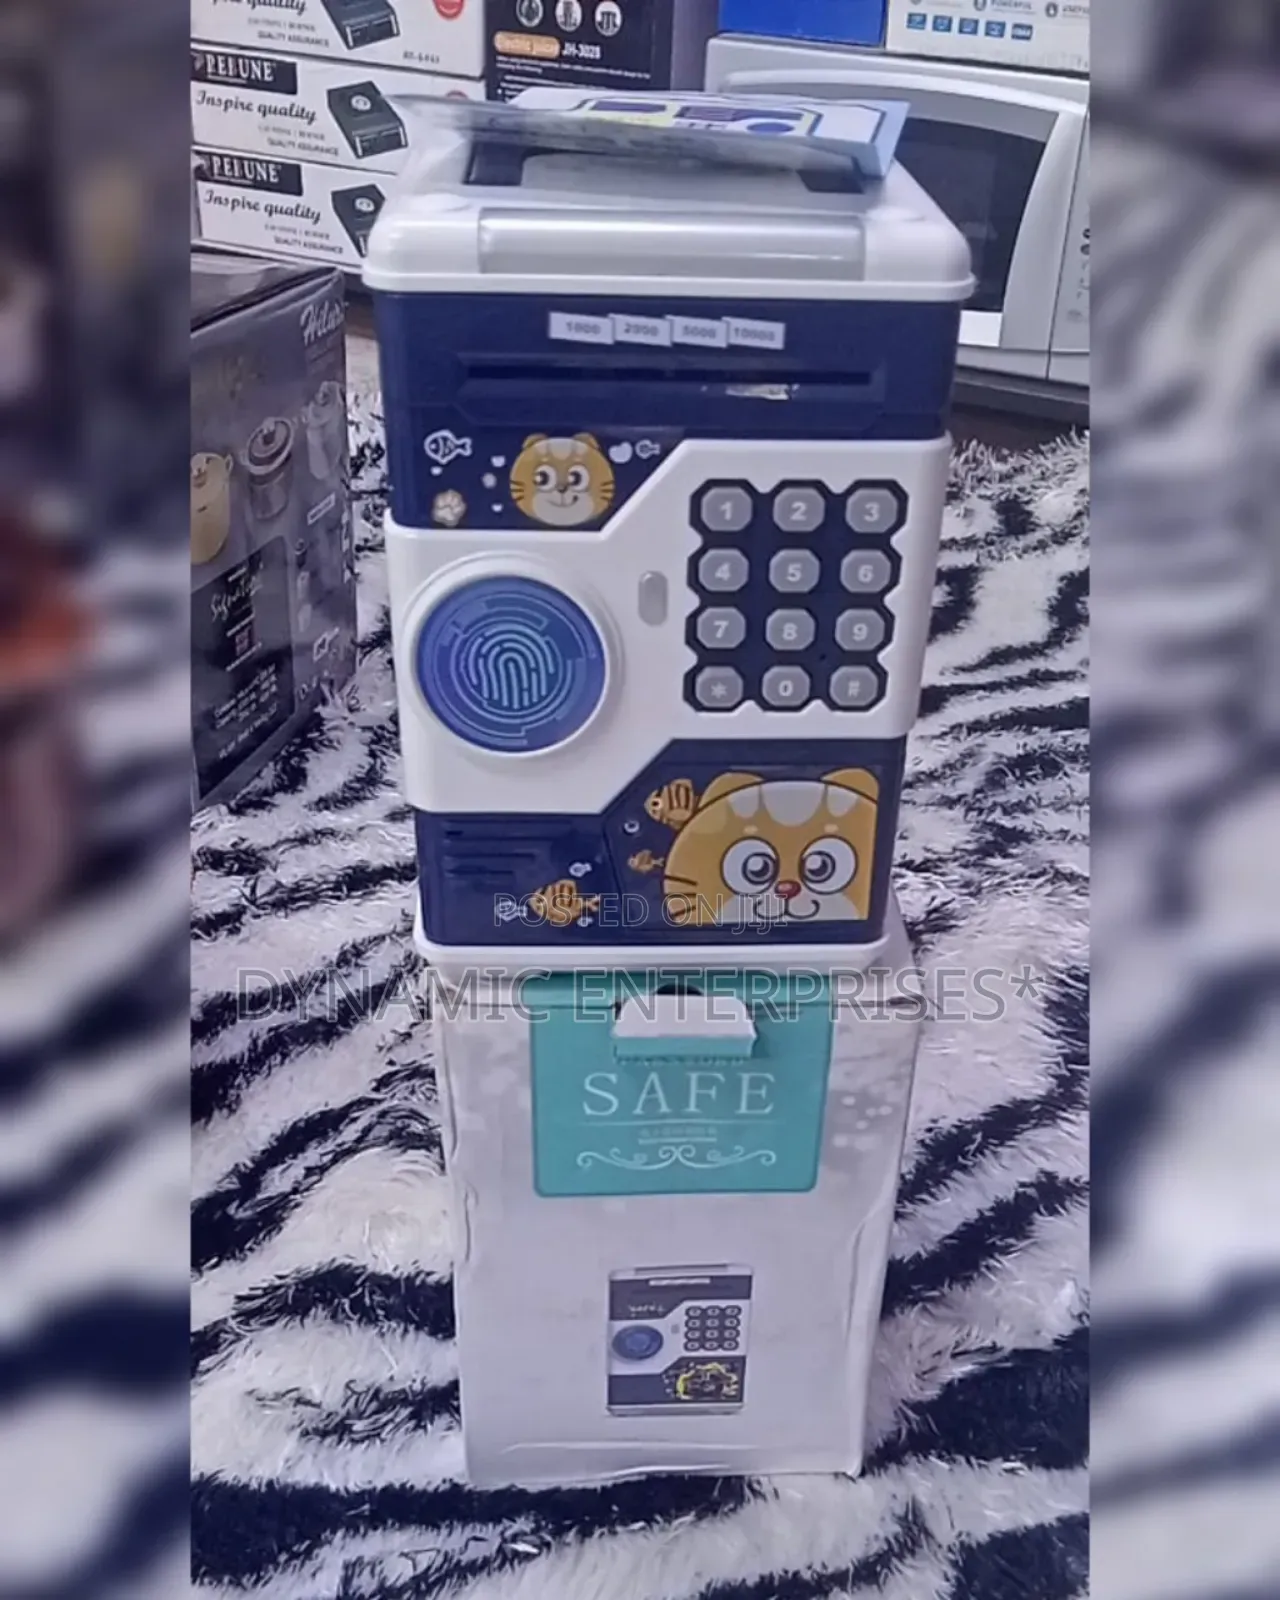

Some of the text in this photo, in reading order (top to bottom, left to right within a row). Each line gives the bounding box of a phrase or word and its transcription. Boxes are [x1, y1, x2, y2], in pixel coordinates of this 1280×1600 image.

[196, 90, 317, 125] Inspire quality
[204, 189, 321, 225] Inspire quality
[719, 501, 880, 522] 1 2 3
[714, 563, 874, 582] 4 5 6
[713, 620, 868, 641] 7 8 9
[778, 680, 794, 697] 0
[583, 1071, 776, 1116] SAFE
